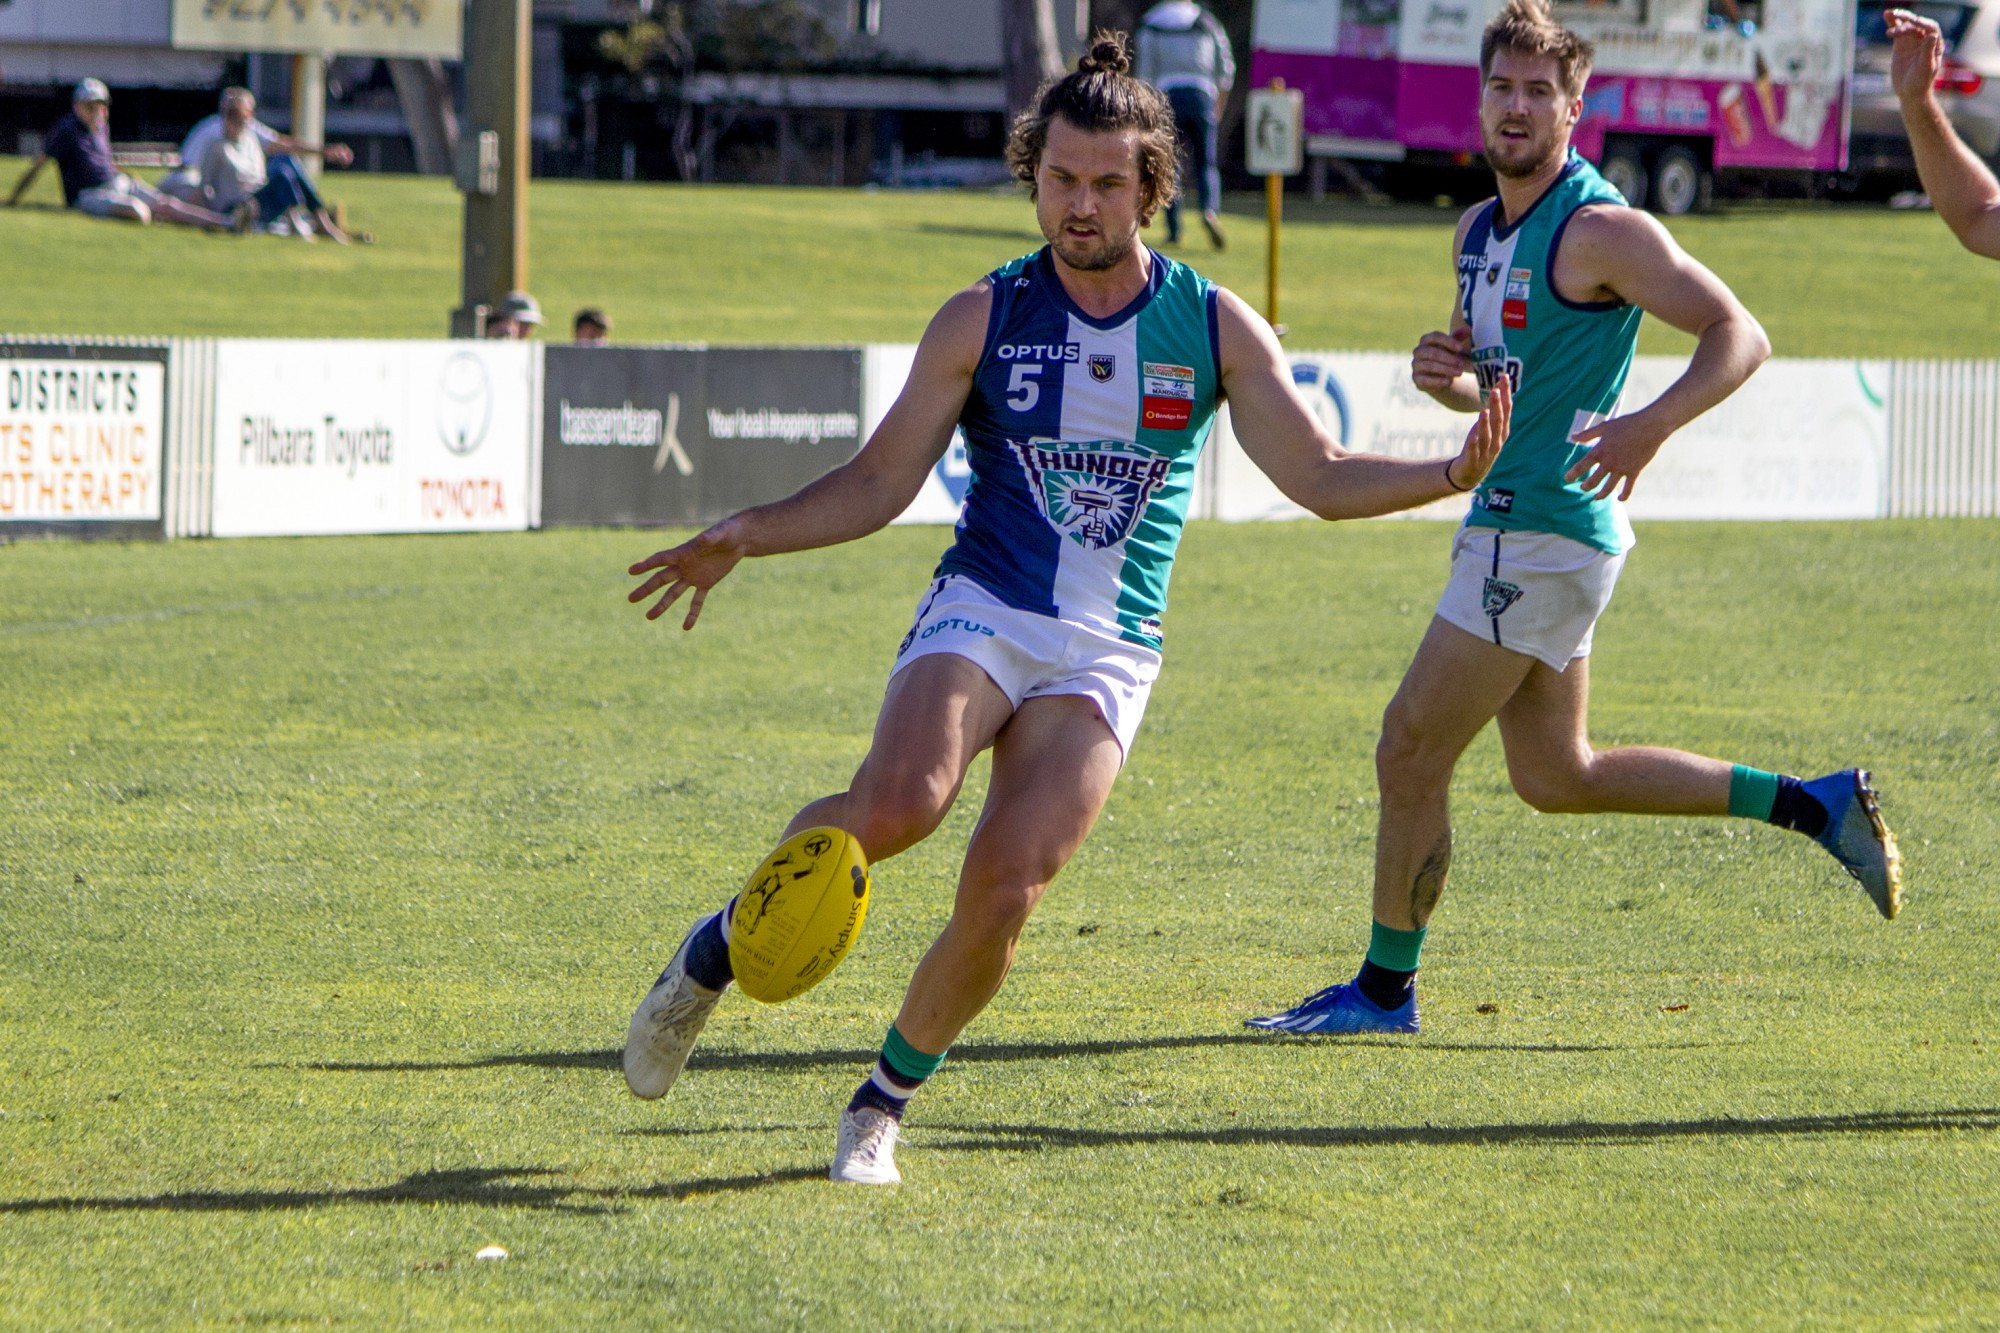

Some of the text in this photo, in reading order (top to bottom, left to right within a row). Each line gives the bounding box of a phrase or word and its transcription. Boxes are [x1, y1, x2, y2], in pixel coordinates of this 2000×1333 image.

[997, 344, 1079, 362] OPTUS
[8, 369, 138, 413] DISTRICTS
[1006, 363, 1043, 413] 5
[1155, 412, 1177, 421] Bendigo
[50, 424, 145, 464] CLINIC
[240, 414, 394, 479] Pilbara Toyota
[1013, 441, 1172, 489] THUNDER
[0, 471, 153, 512] OTHERAPY
[418, 479, 508, 519] TOYOTA
[920, 618, 996, 640] OPTUS
